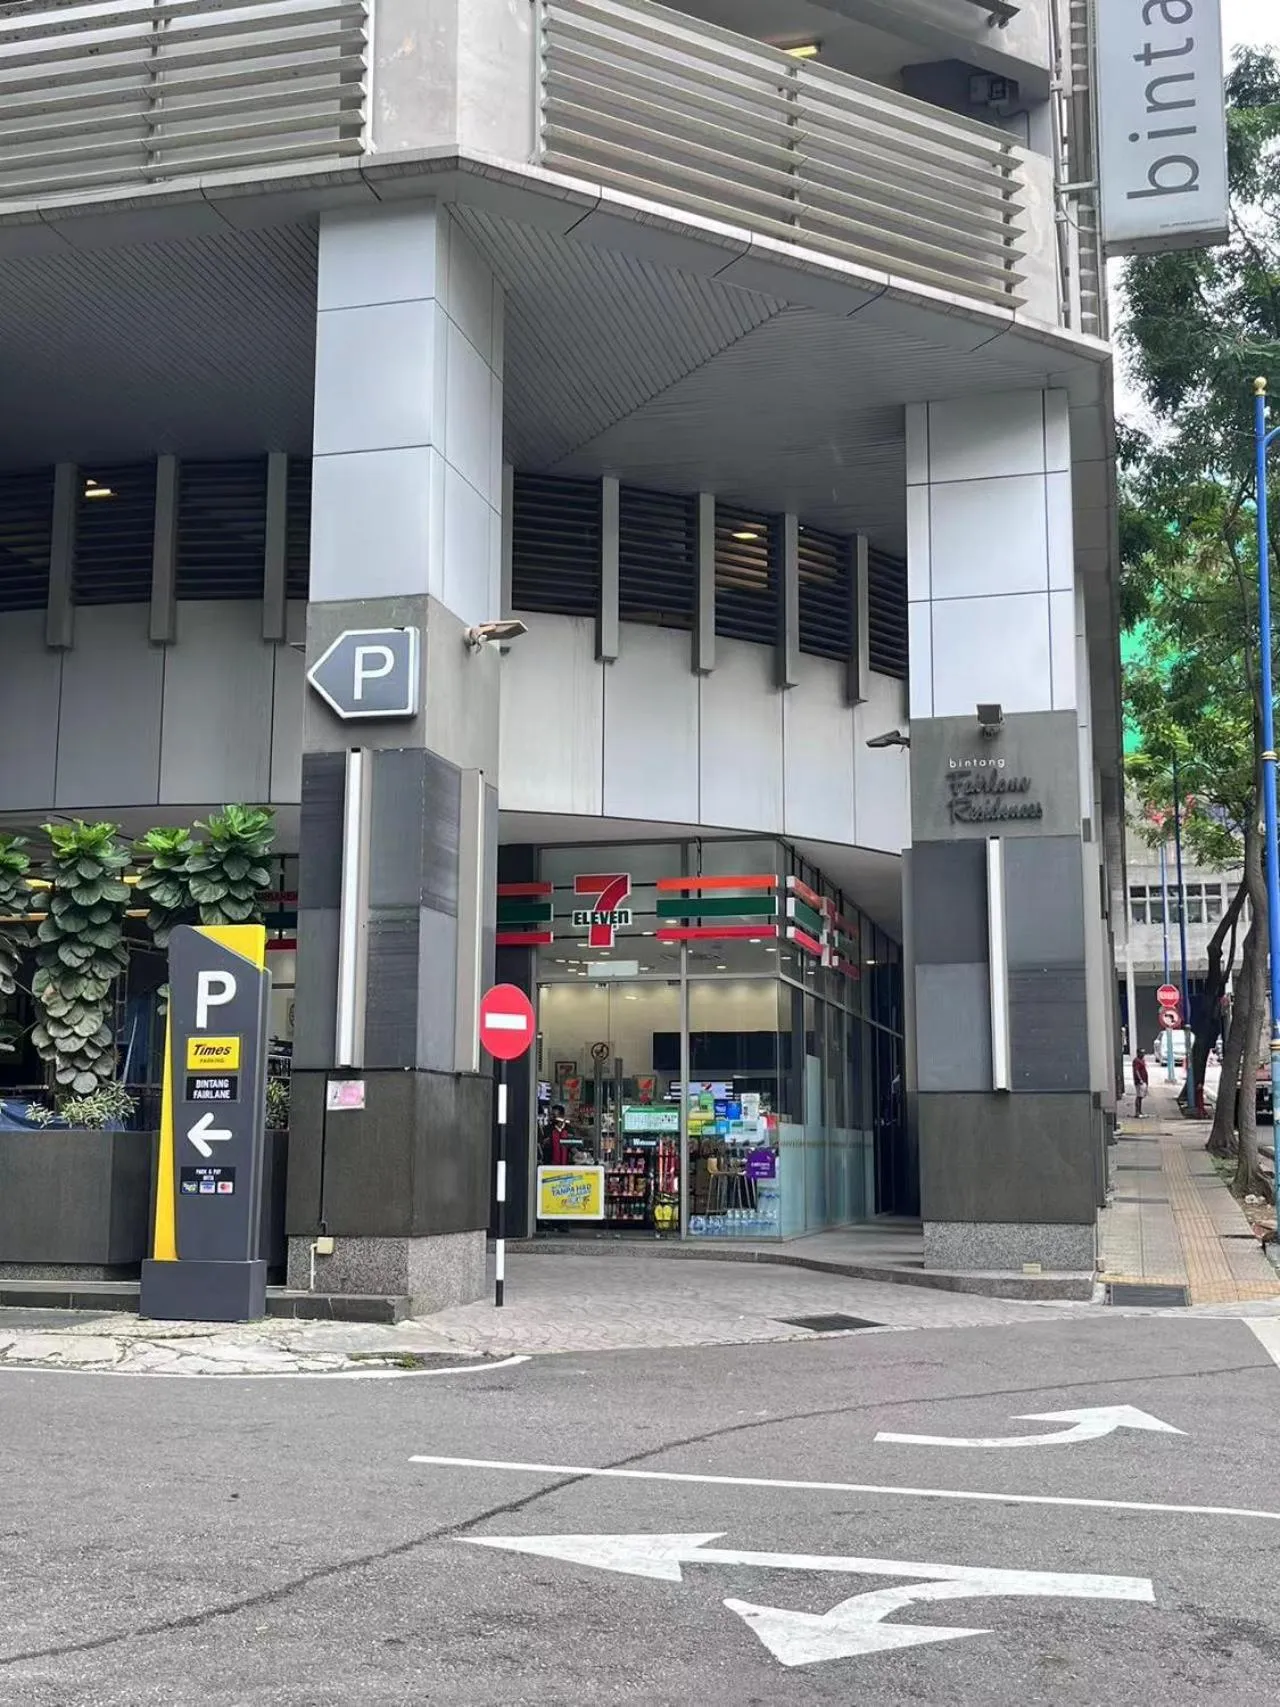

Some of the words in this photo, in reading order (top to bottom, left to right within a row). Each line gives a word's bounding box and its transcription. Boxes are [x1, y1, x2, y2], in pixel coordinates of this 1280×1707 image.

[1126, 0, 1200, 200] binta
[353, 645, 395, 700] P
[949, 758, 1006, 768] bintang
[573, 873, 632, 949] 7
[196, 970, 237, 1029] P
[193, 1044, 232, 1056] Times
[193, 1089, 231, 1099] FAIRLANE
[195, 1079, 230, 1089] BINTANG
